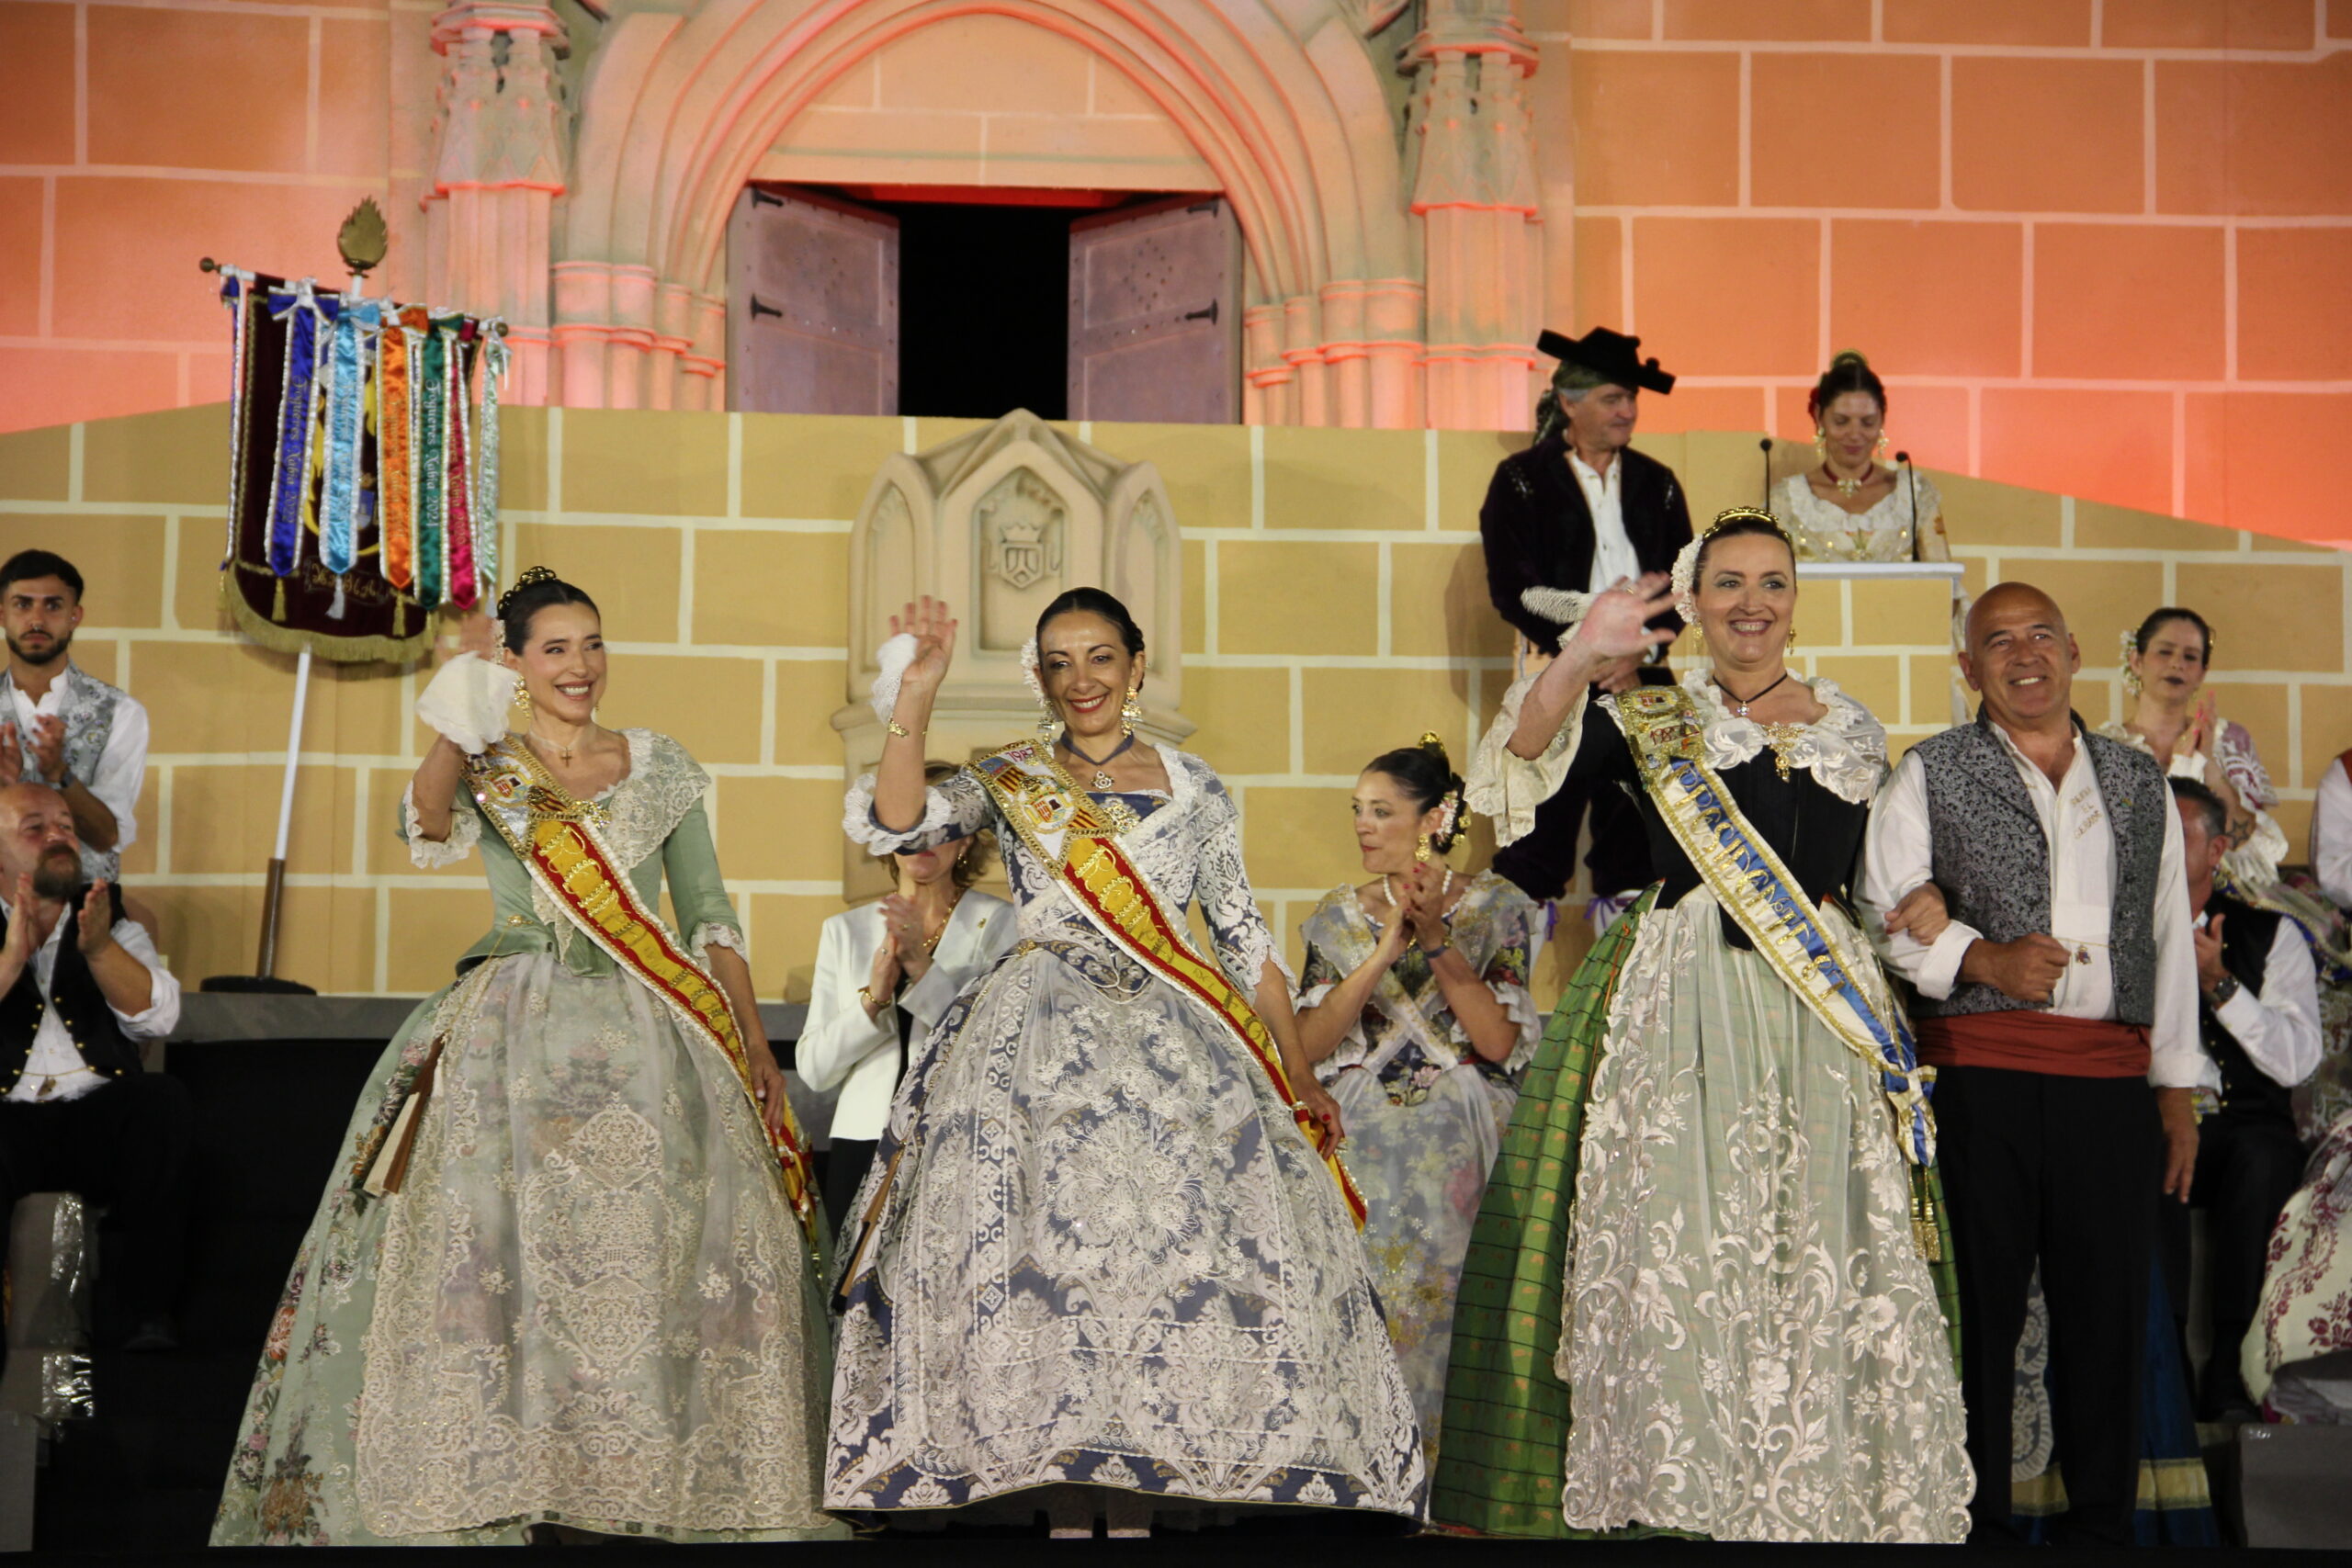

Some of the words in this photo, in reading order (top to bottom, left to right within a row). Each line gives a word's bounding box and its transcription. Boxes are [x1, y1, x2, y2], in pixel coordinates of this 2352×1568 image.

[288, 375, 308, 441] Fogueres
[424, 378, 441, 446] Fogueres
[1661, 762, 1810, 953] PRESIDENTA
